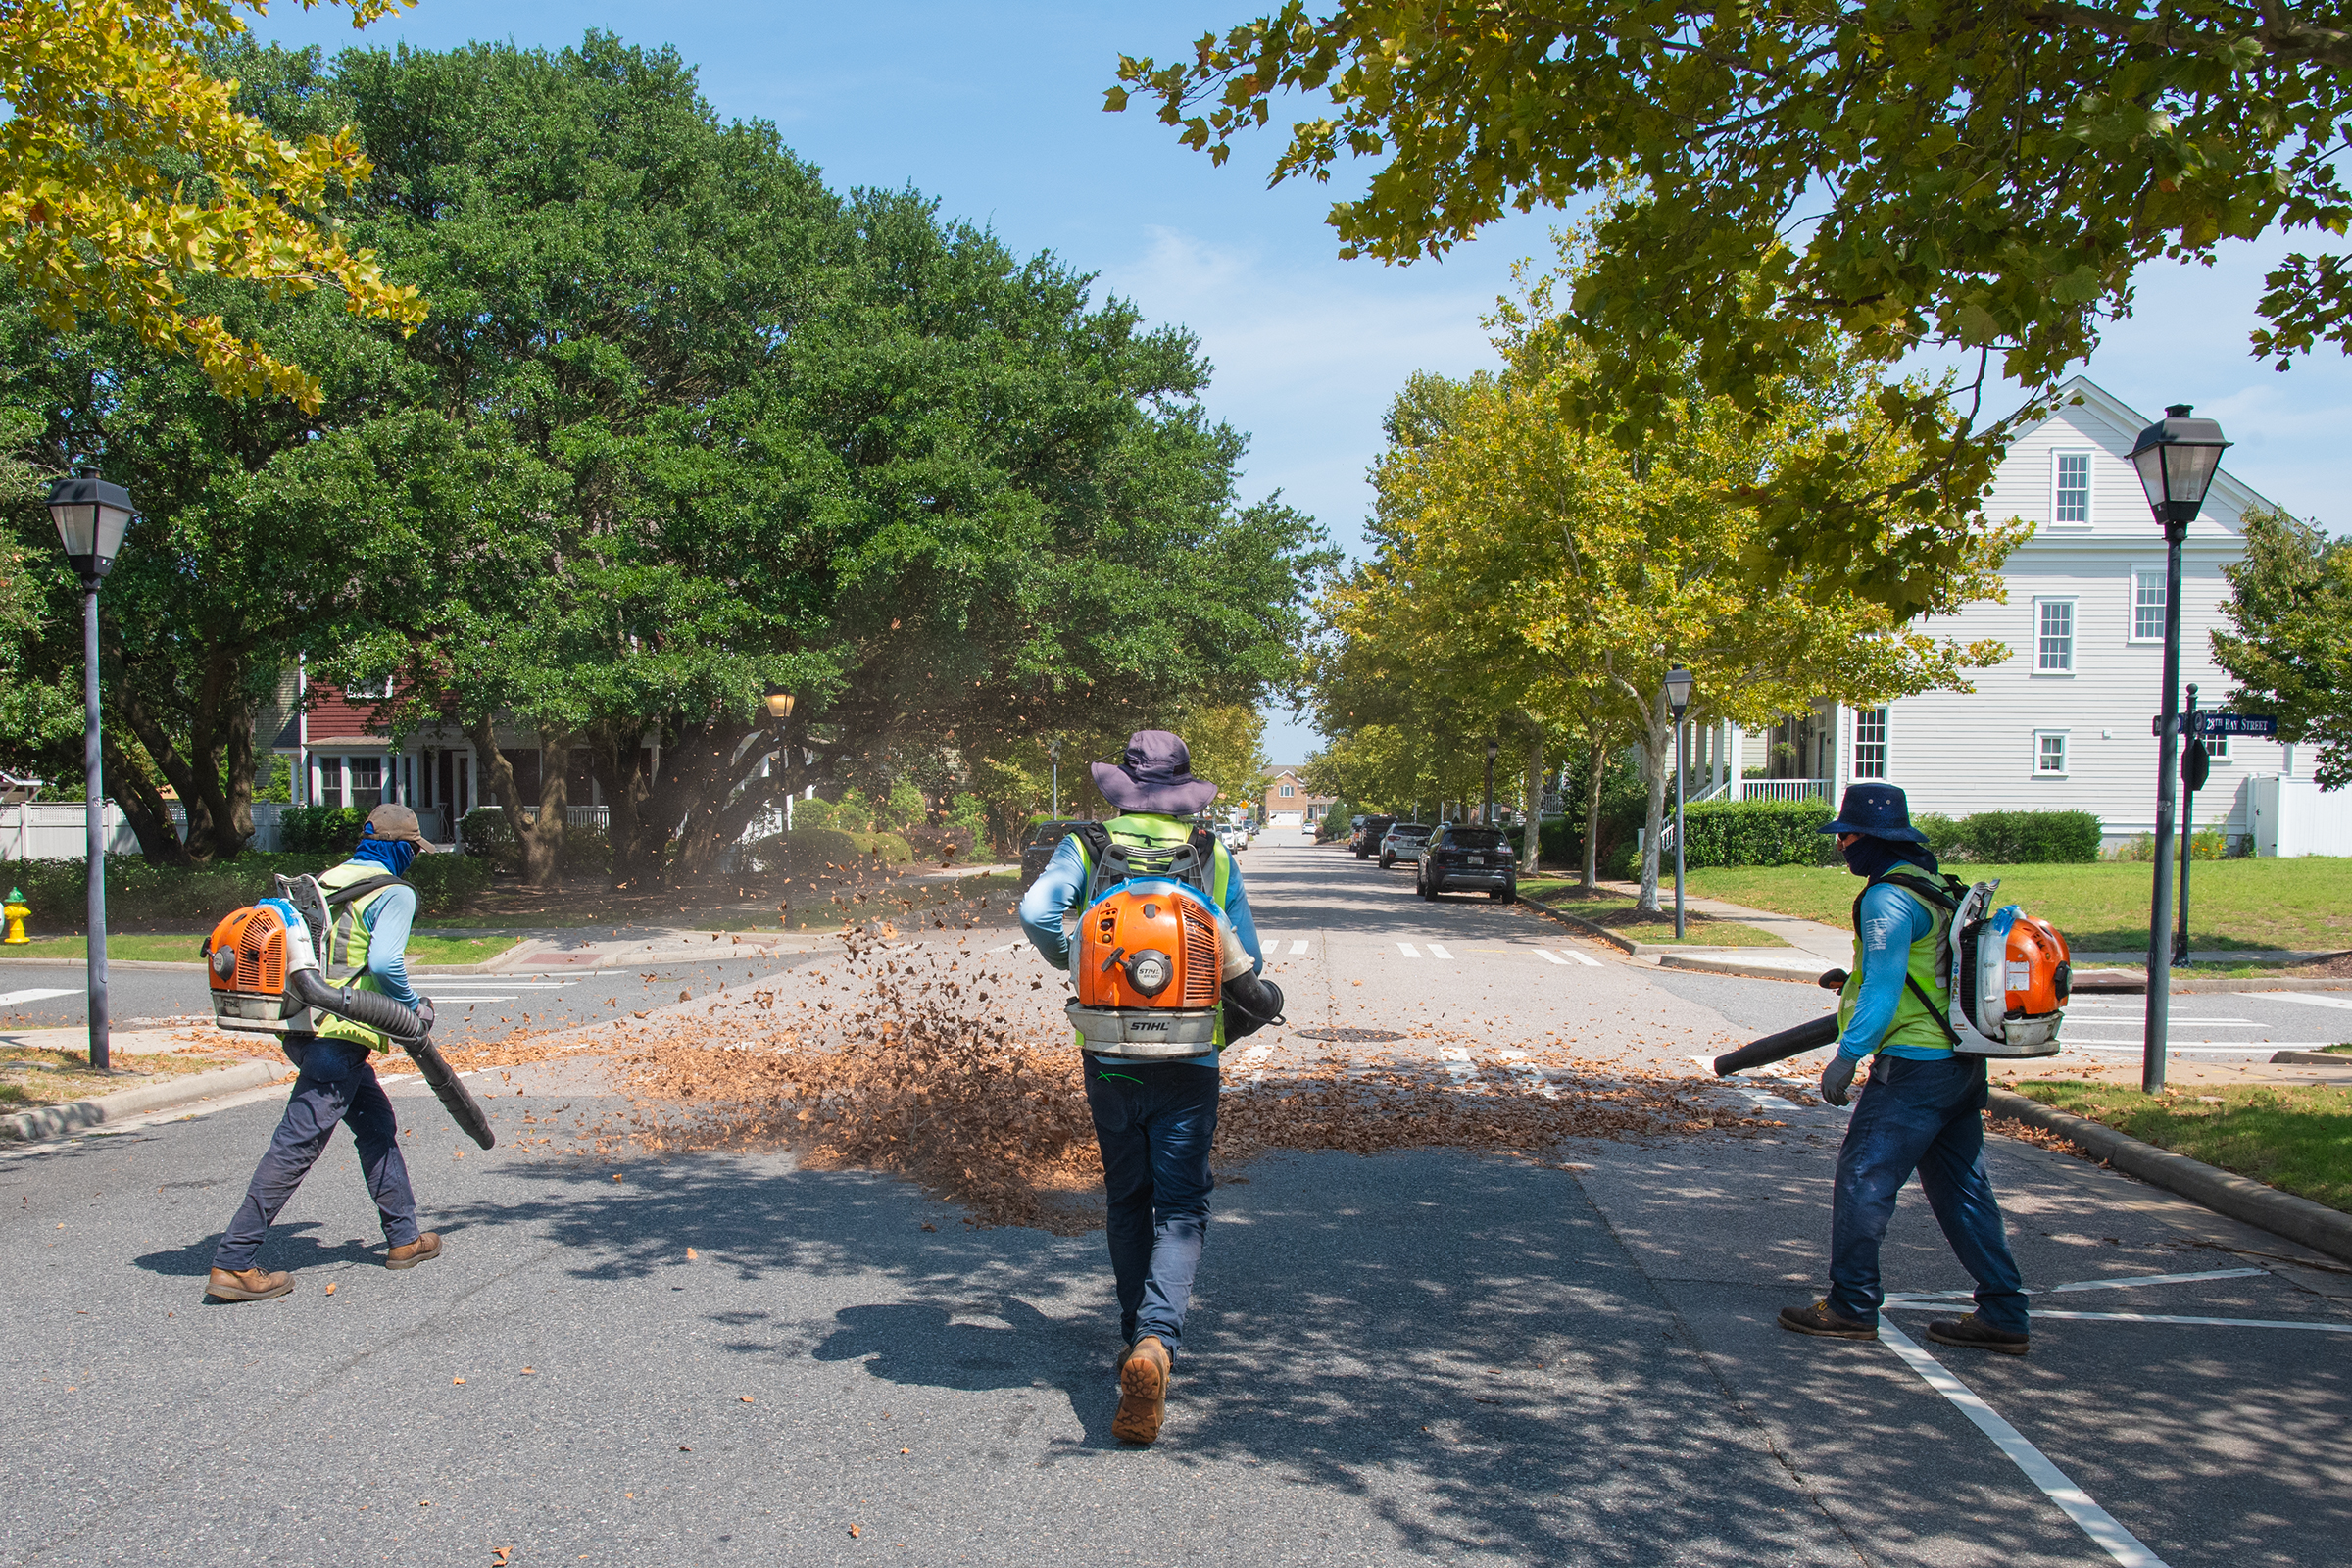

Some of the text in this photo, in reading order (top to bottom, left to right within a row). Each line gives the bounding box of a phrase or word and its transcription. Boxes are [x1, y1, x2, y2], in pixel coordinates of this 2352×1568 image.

[2206, 718, 2268, 730] 28TH BAY STREET
[1130, 1022, 1169, 1030] STIHL
